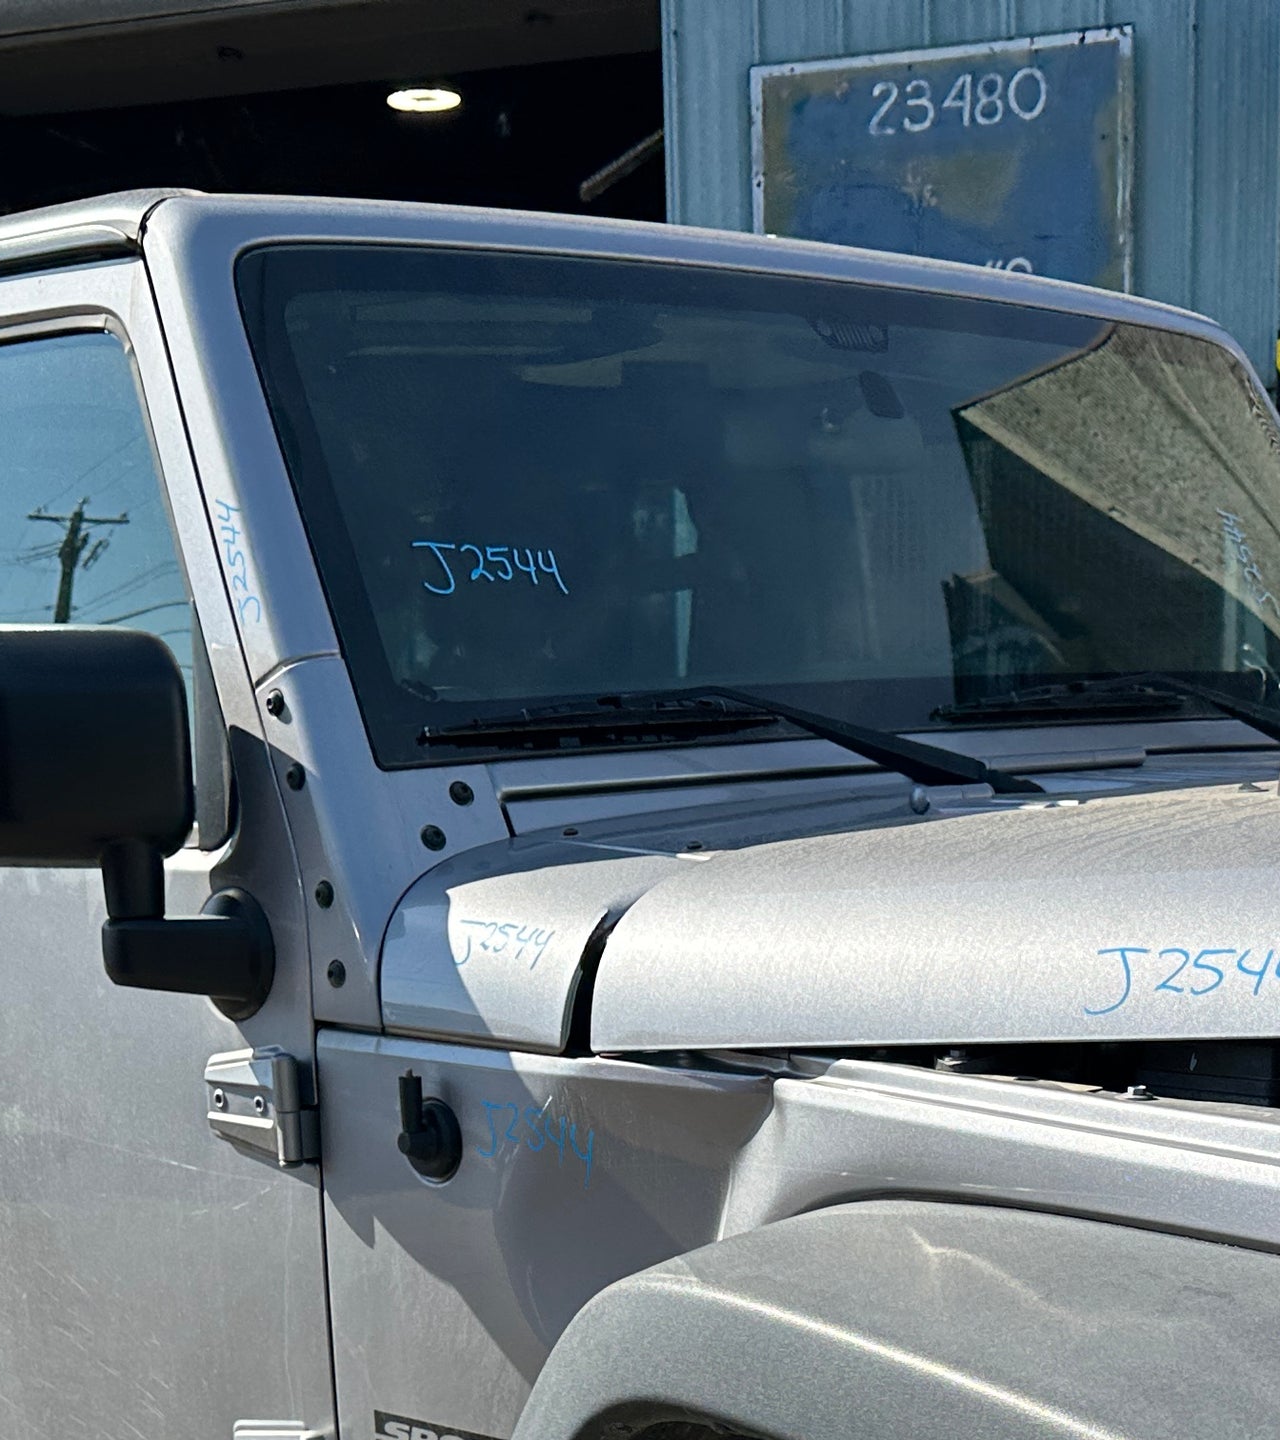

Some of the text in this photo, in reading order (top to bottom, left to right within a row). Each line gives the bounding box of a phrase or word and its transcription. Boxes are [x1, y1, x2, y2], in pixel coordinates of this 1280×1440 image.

[869, 67, 1047, 136] 23480
[412, 541, 569, 595] J2544
[453, 919, 556, 970] J2544
[477, 1100, 595, 1190] J2544
